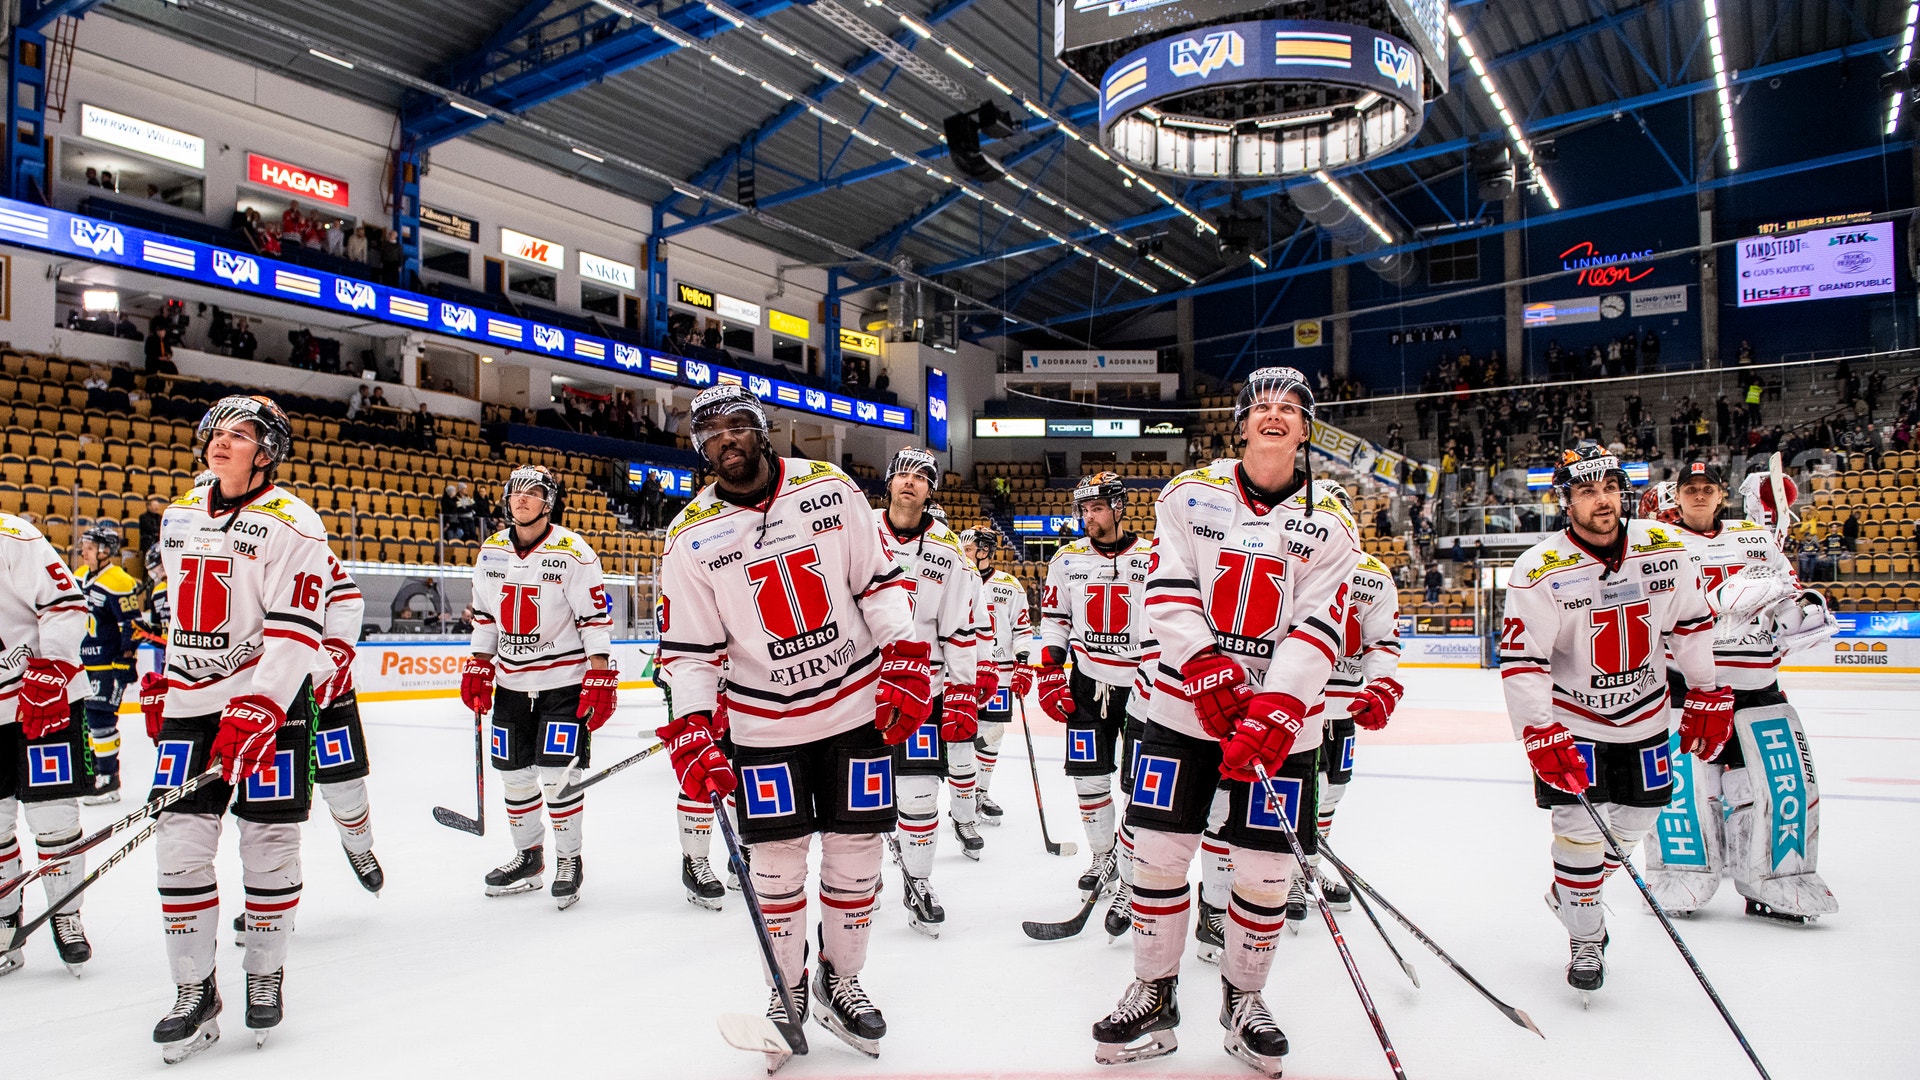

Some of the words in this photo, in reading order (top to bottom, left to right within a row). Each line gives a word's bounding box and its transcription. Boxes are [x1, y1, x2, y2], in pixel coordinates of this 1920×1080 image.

[1169, 30, 1244, 78] HV71
[70, 217, 124, 255] HV71
[1836, 232, 1868, 245] TAK
[1745, 239, 1802, 259] SANDSTEDT
[213, 250, 260, 285] HV71
[1743, 284, 1812, 300] Hestra
[1818, 282, 1855, 292] GRAND
[1855, 278, 1893, 288] PUBLIC
[336, 278, 376, 310] HV71
[441, 302, 477, 332] HV71
[534, 324, 564, 351] HV71
[1392, 329, 1457, 345] PRIMA
[1041, 358, 1088, 366] ADDBRAND
[1108, 358, 1155, 366] ADDBRAND
[1049, 424, 1092, 432] TOSITO
[1196, 500, 1232, 513] CONTRACTING
[812, 514, 841, 533] OBK
[700, 528, 735, 546] CONTRACTING
[233, 540, 258, 556] OBK
[1746, 550, 1766, 559] OBK
[542, 572, 563, 581] OBK
[922, 567, 945, 581] OBK
[291, 571, 323, 611] 16
[1650, 577, 1675, 591] OBK
[119, 595, 139, 613] 26
[1042, 585, 1059, 609] 24
[1353, 590, 1376, 603] OBK
[174, 631, 225, 648] ÖREBRO
[1086, 631, 1127, 643] ÖREBRO
[1501, 617, 1525, 650] 22
[773, 626, 836, 658] ÖREBRO
[1834, 653, 1888, 665] EKSJÖHUS
[1684, 699, 1734, 711] BAUER
[1526, 729, 1573, 752] BAUER
[1795, 730, 1816, 785] BAUER
[1761, 728, 1799, 847] HEROK
[111, 780, 198, 837] BAUER
[164, 927, 199, 935] STILL
[247, 924, 281, 933] STILL
